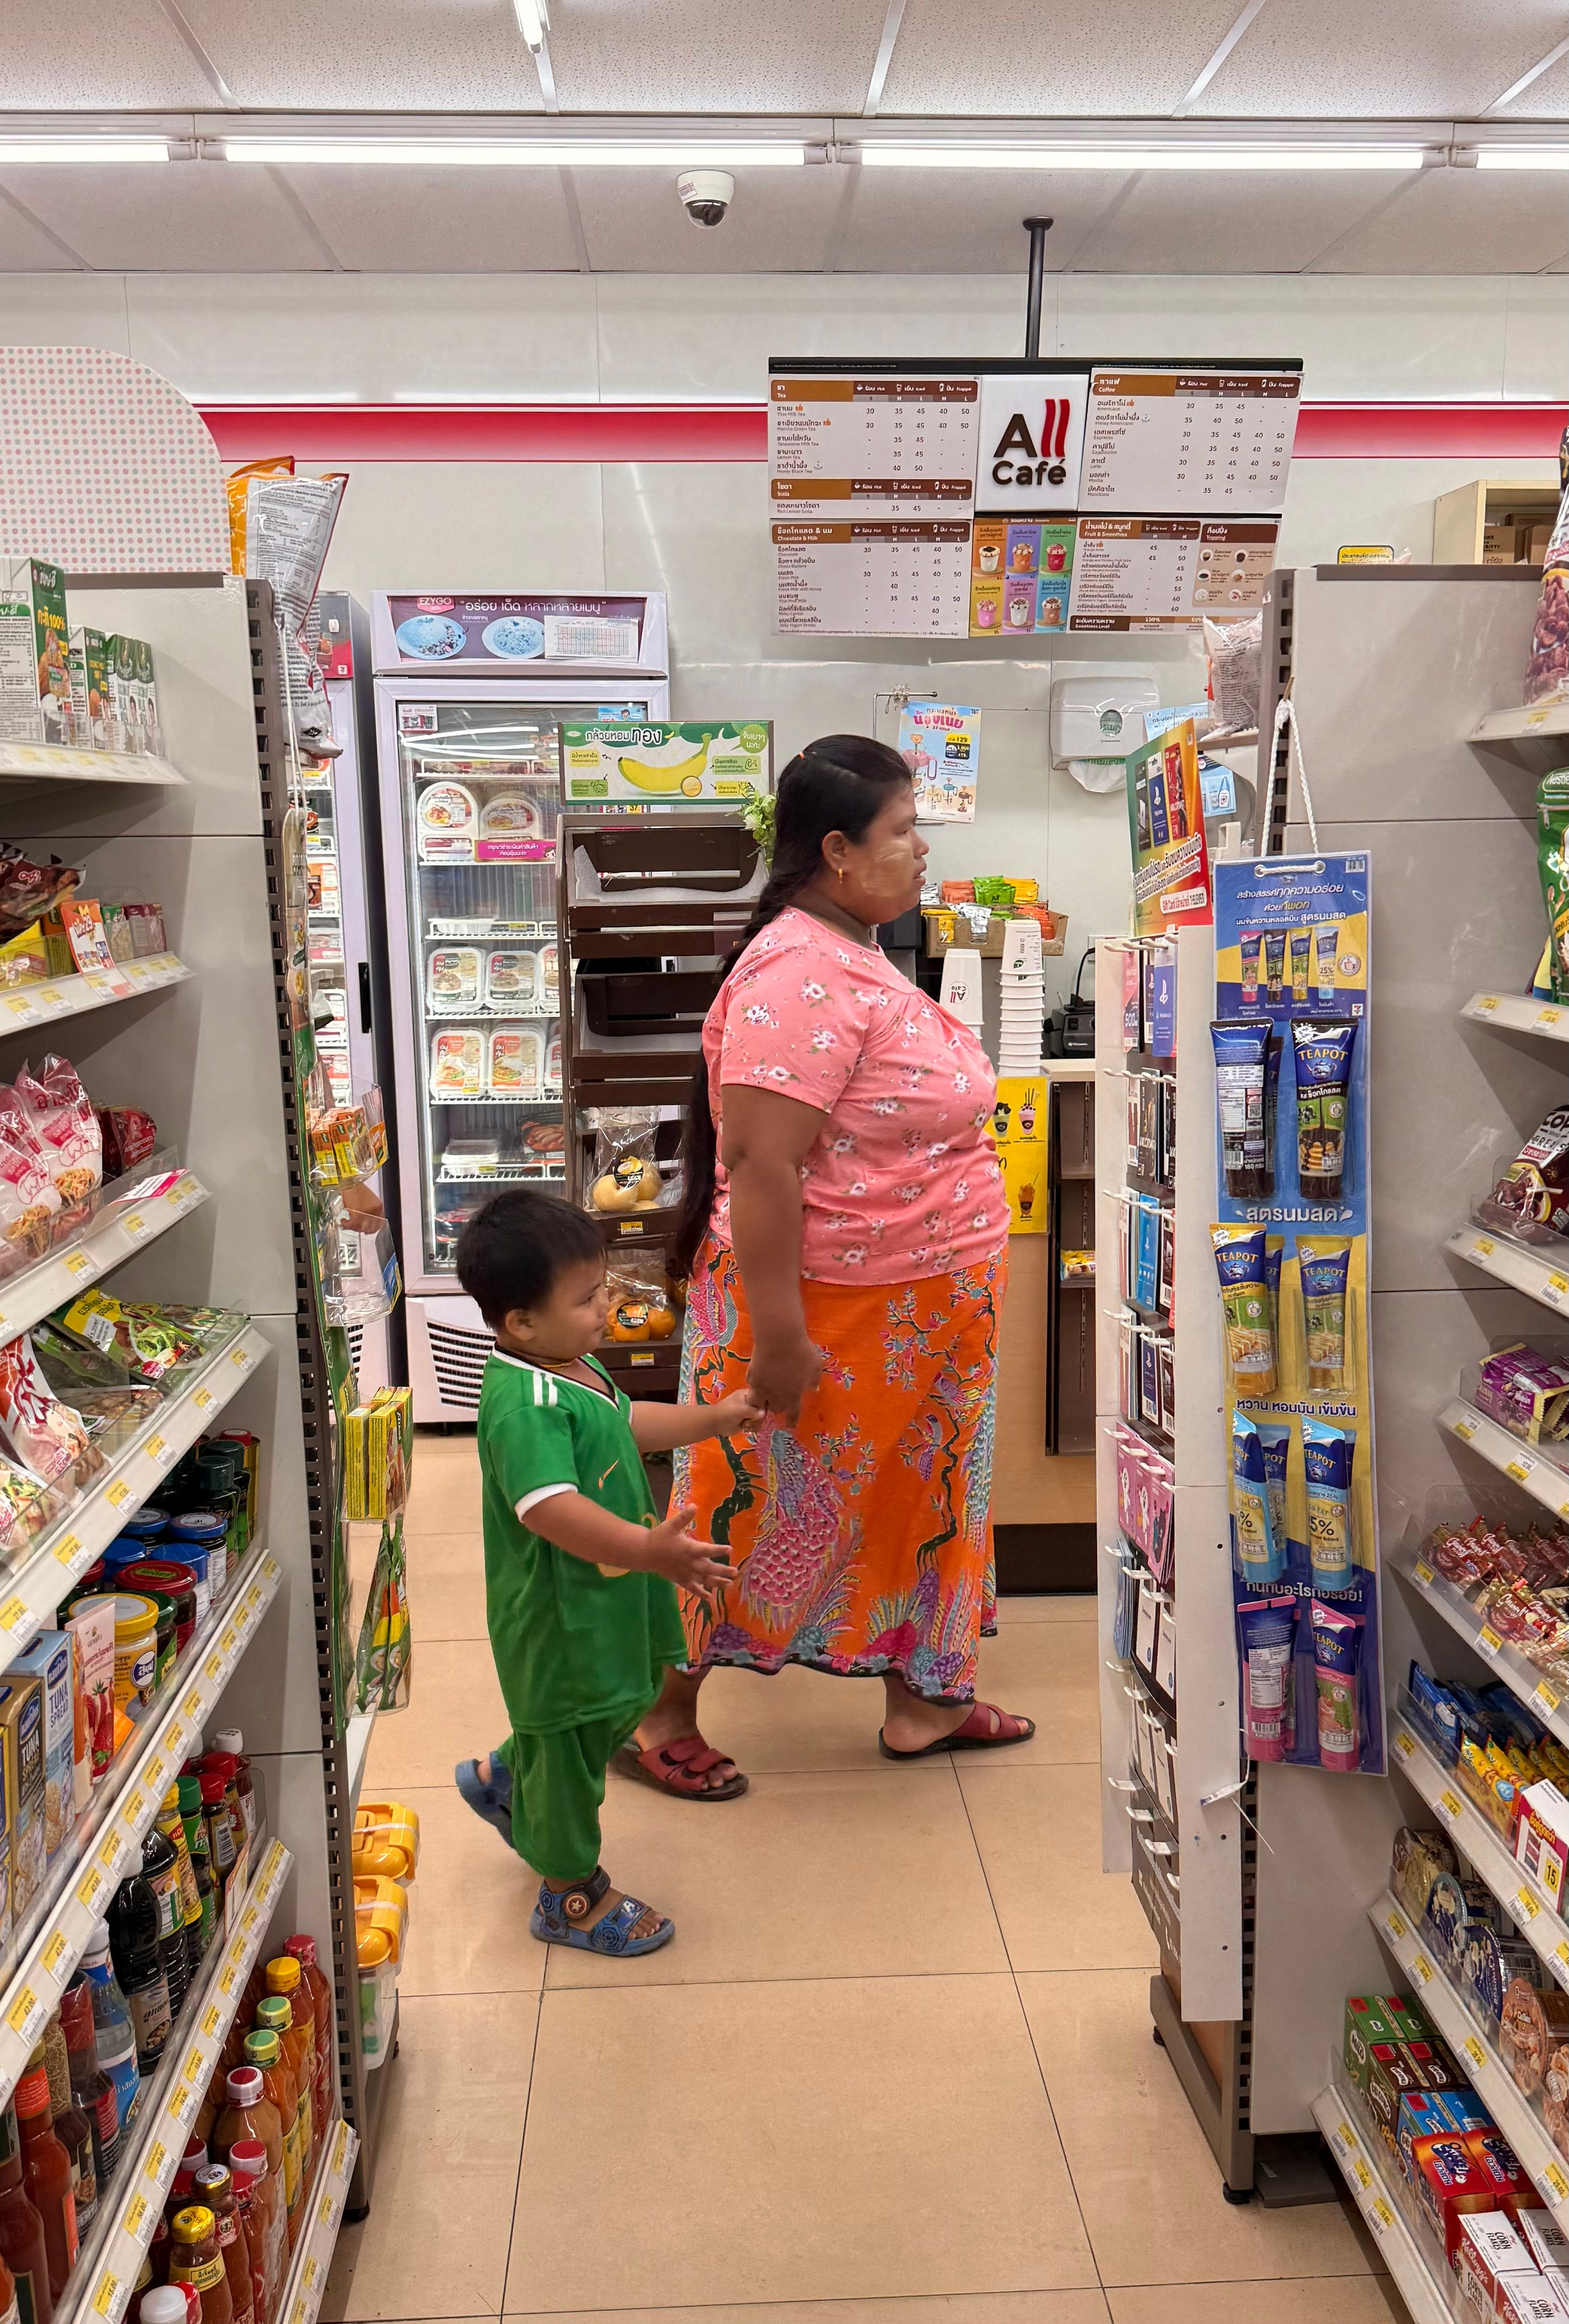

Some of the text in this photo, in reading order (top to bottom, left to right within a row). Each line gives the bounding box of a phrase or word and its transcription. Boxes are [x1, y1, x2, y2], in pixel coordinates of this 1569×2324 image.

[993, 399, 1070, 458] All
[992, 458, 1067, 485] Café
[419, 597, 452, 606] EZYGO
[501, 598, 521, 612] เด็ด
[49, 615, 66, 631] 100%
[1236, 911, 1347, 925] นมข้นหวานหลอดบีบ สูตรนมสด
[1297, 1049, 1348, 1061] TEAPOT
[1246, 1206, 1338, 1224] สูตรนมสด
[1215, 1252, 1259, 1263] TEAPOT
[1303, 1268, 1346, 1278] TEAPOT
[1237, 1399, 1356, 1416] หวาน หอมมัน เข้มข้น
[1304, 1448, 1336, 1469] TEAPOT
[49, 1685, 68, 1714] TUNA
[50, 1701, 68, 1728] SPREAD
[21, 1729, 40, 1764] TUNA
[89, 1877, 101, 1893] 42.00
[53, 1939, 67, 1957] 42.00
[21, 1997, 36, 2016] 42.00
[1551, 2178, 1567, 2196] 20.00
[1486, 2233, 1502, 2250] FLAKES
[1494, 2231, 1512, 2250] CORN
[1541, 2228, 1555, 2246] FLAKES
[1550, 2228, 1566, 2246] CORN
[1527, 2299, 1544, 2319] FLAKES
[1537, 2299, 1555, 2318] CORN
